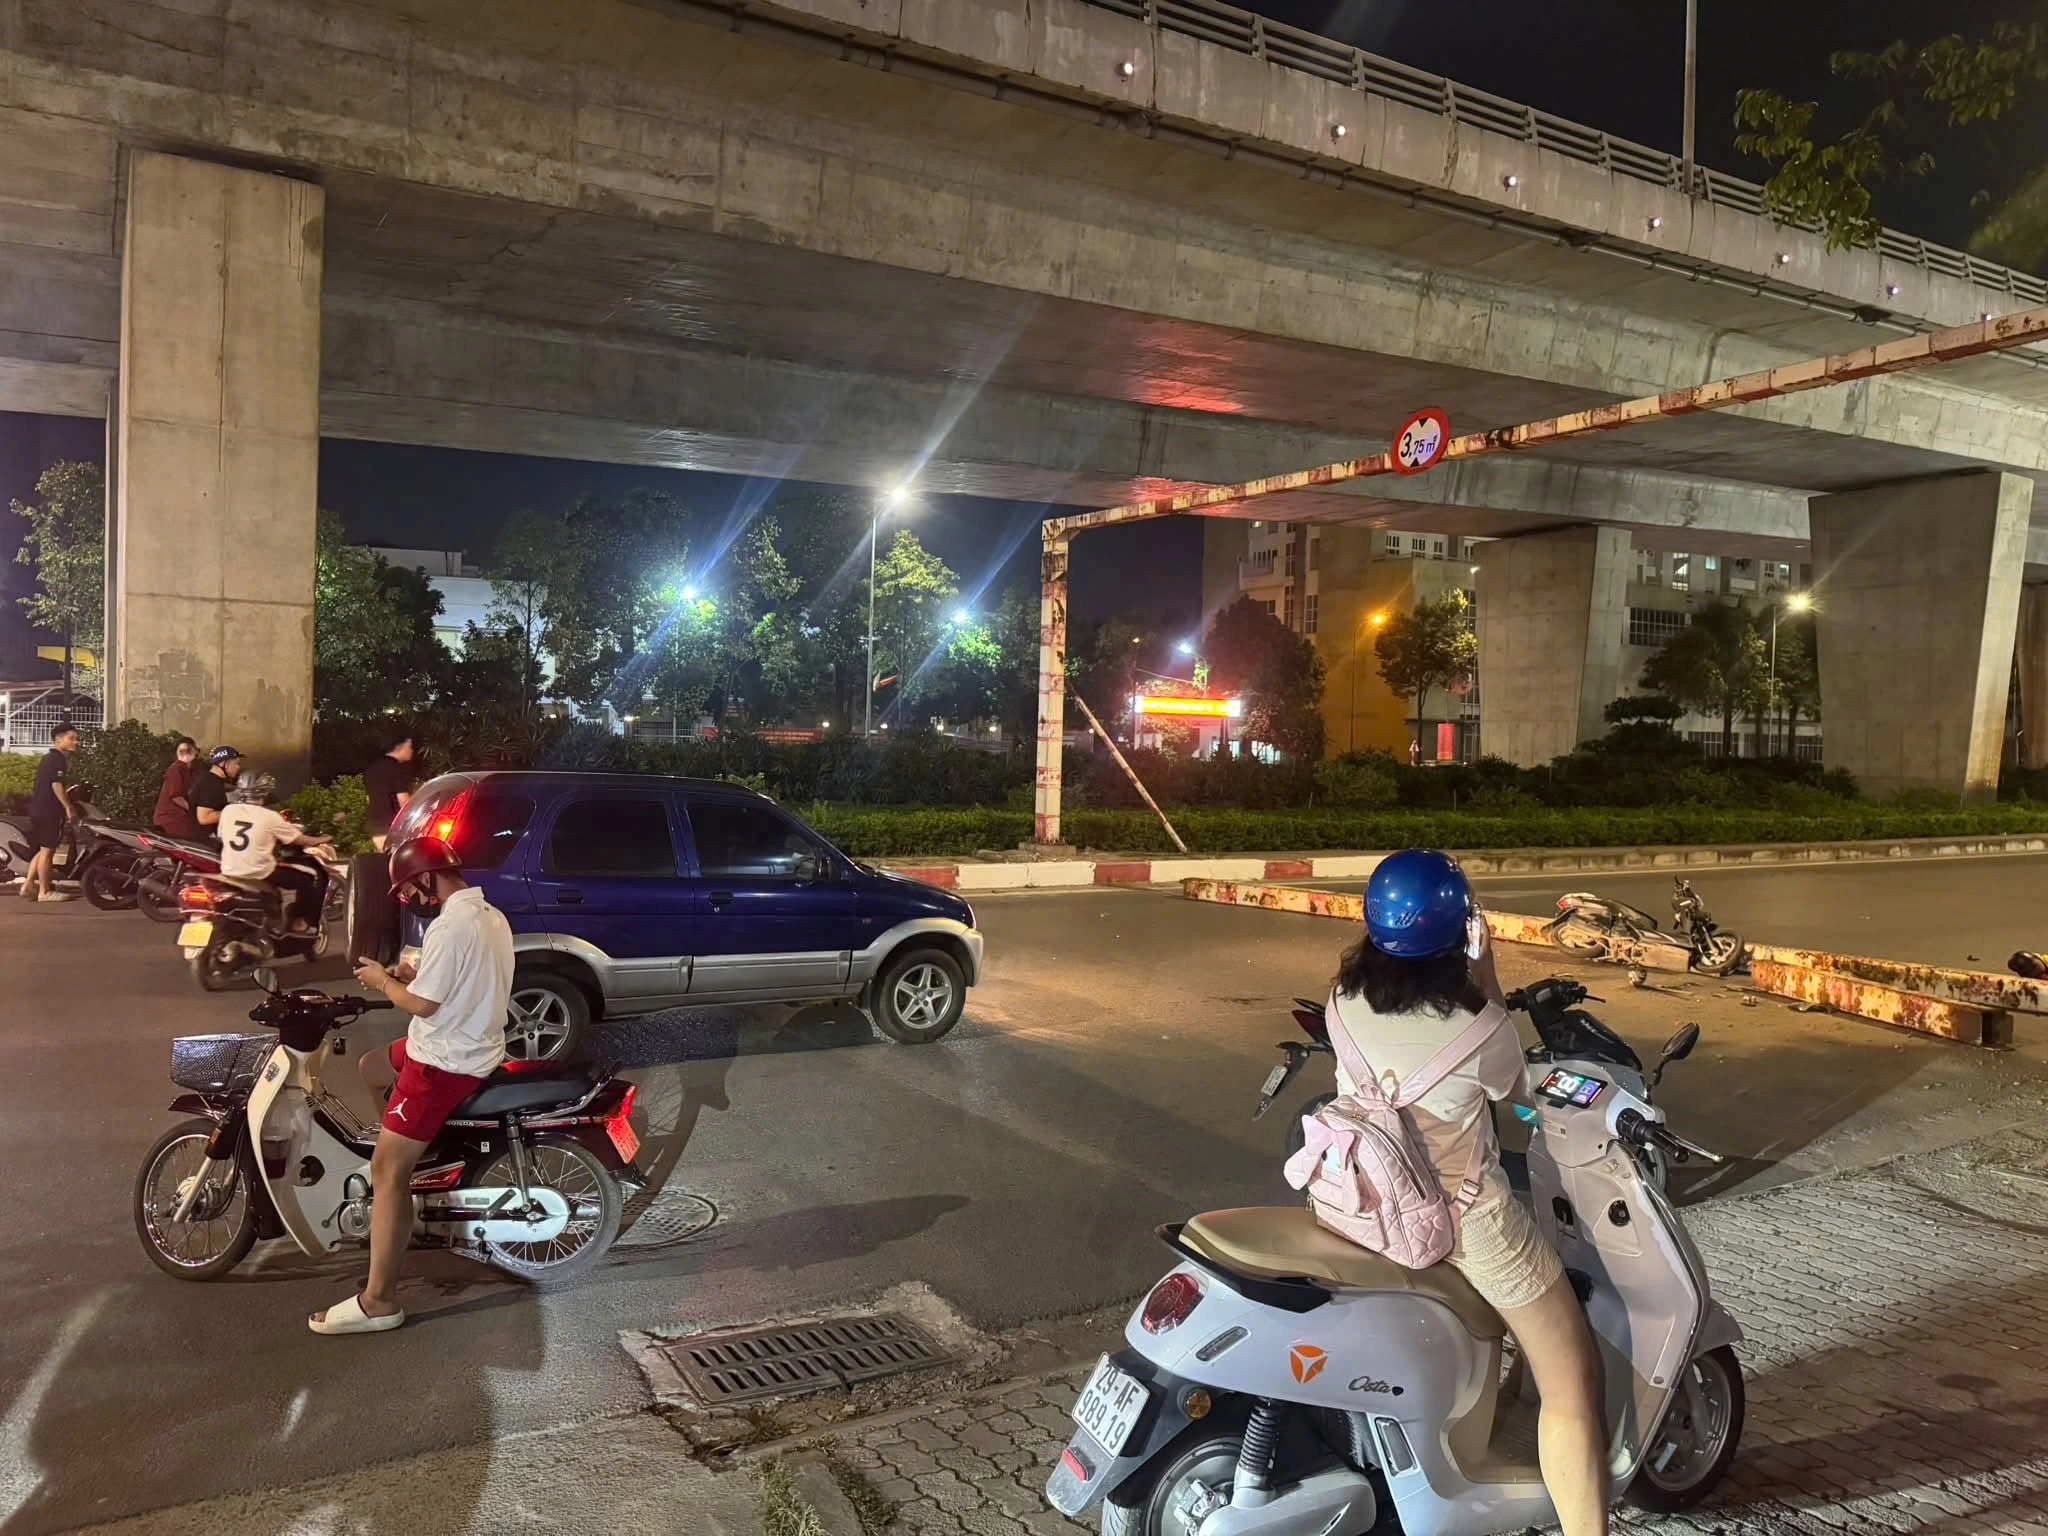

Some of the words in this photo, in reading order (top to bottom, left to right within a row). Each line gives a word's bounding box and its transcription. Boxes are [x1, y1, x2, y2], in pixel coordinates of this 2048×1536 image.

[229, 820, 254, 851] 3
[1348, 1375, 1392, 1393] Osta
[1078, 1389, 1127, 1450] 989.19
